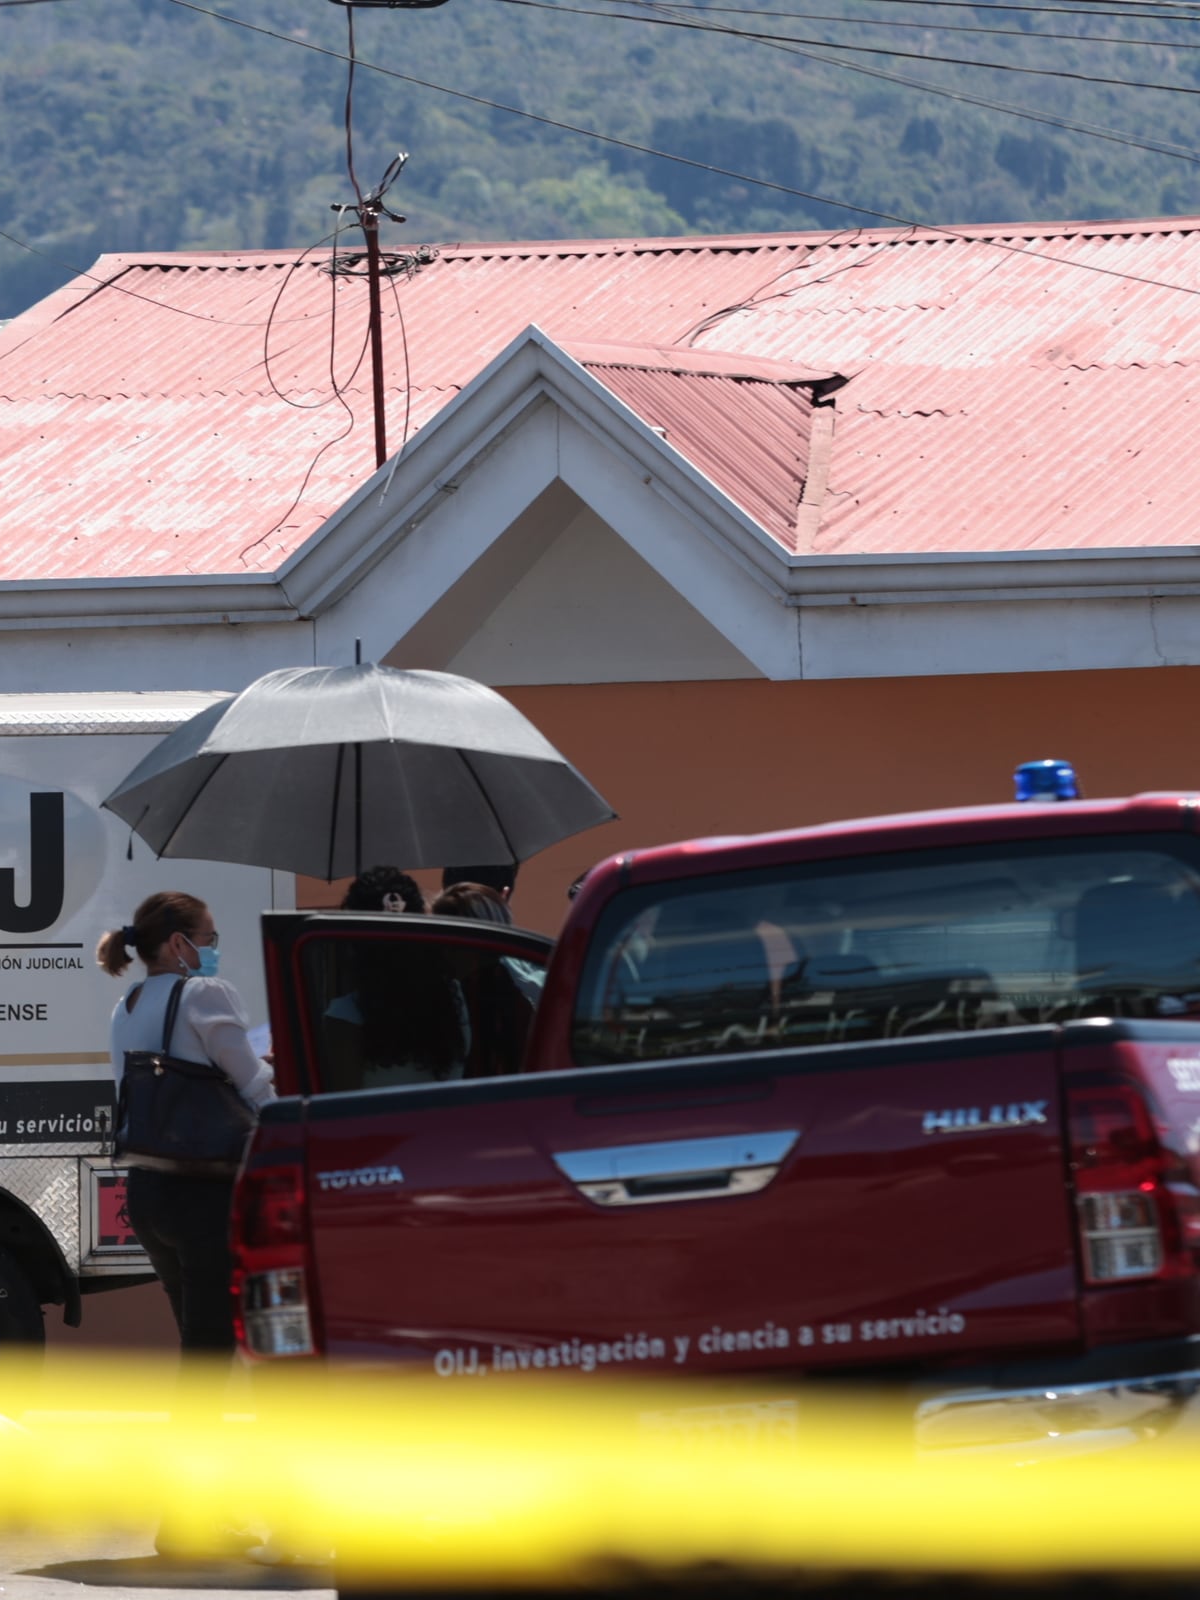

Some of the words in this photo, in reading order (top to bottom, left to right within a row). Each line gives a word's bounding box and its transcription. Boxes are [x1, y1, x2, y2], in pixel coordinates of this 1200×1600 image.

[25, 957, 84, 970] JUDICIAL
[16, 1113, 94, 1134] servicio
[922, 1100, 1048, 1135] HILUX
[316, 1165, 404, 1190] TOYOTA
[434, 1346, 487, 1377] OIJ,
[492, 1332, 666, 1372] investigación
[674, 1335, 691, 1364] y
[698, 1322, 790, 1353] ciencia
[798, 1325, 814, 1346] a
[822, 1323, 852, 1344] su
[860, 1306, 966, 1341] servicio
